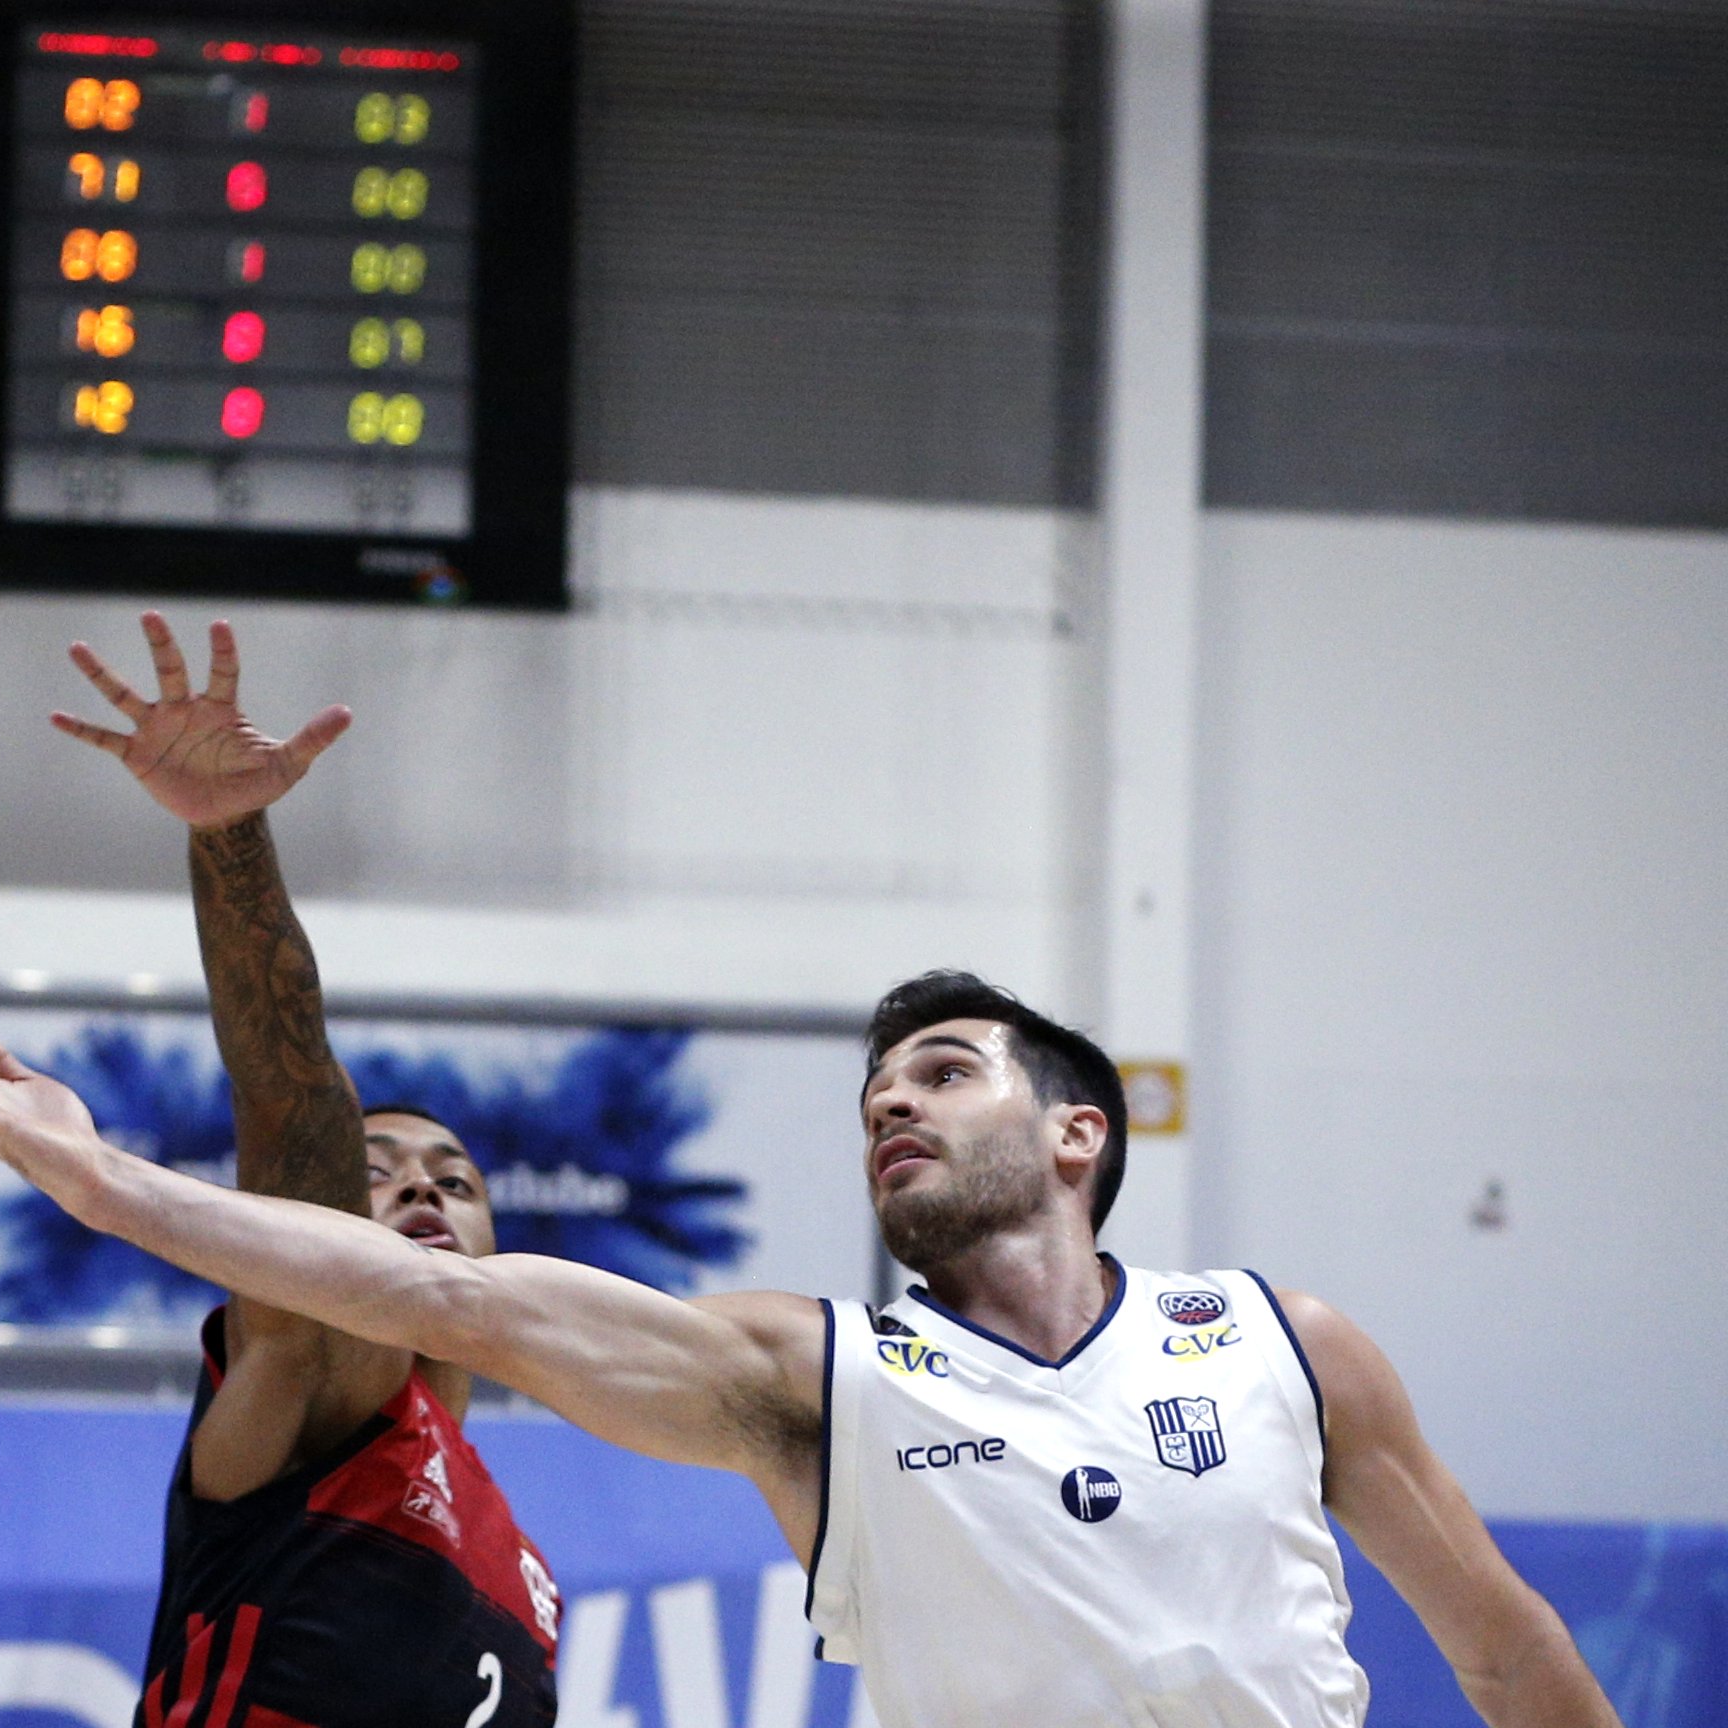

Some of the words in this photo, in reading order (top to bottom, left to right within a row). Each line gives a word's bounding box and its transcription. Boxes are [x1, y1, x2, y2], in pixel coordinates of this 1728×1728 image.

[1161, 1323, 1243, 1356] CVC
[877, 1339, 949, 1378] CVC
[1087, 1481, 1121, 1499] NBB
